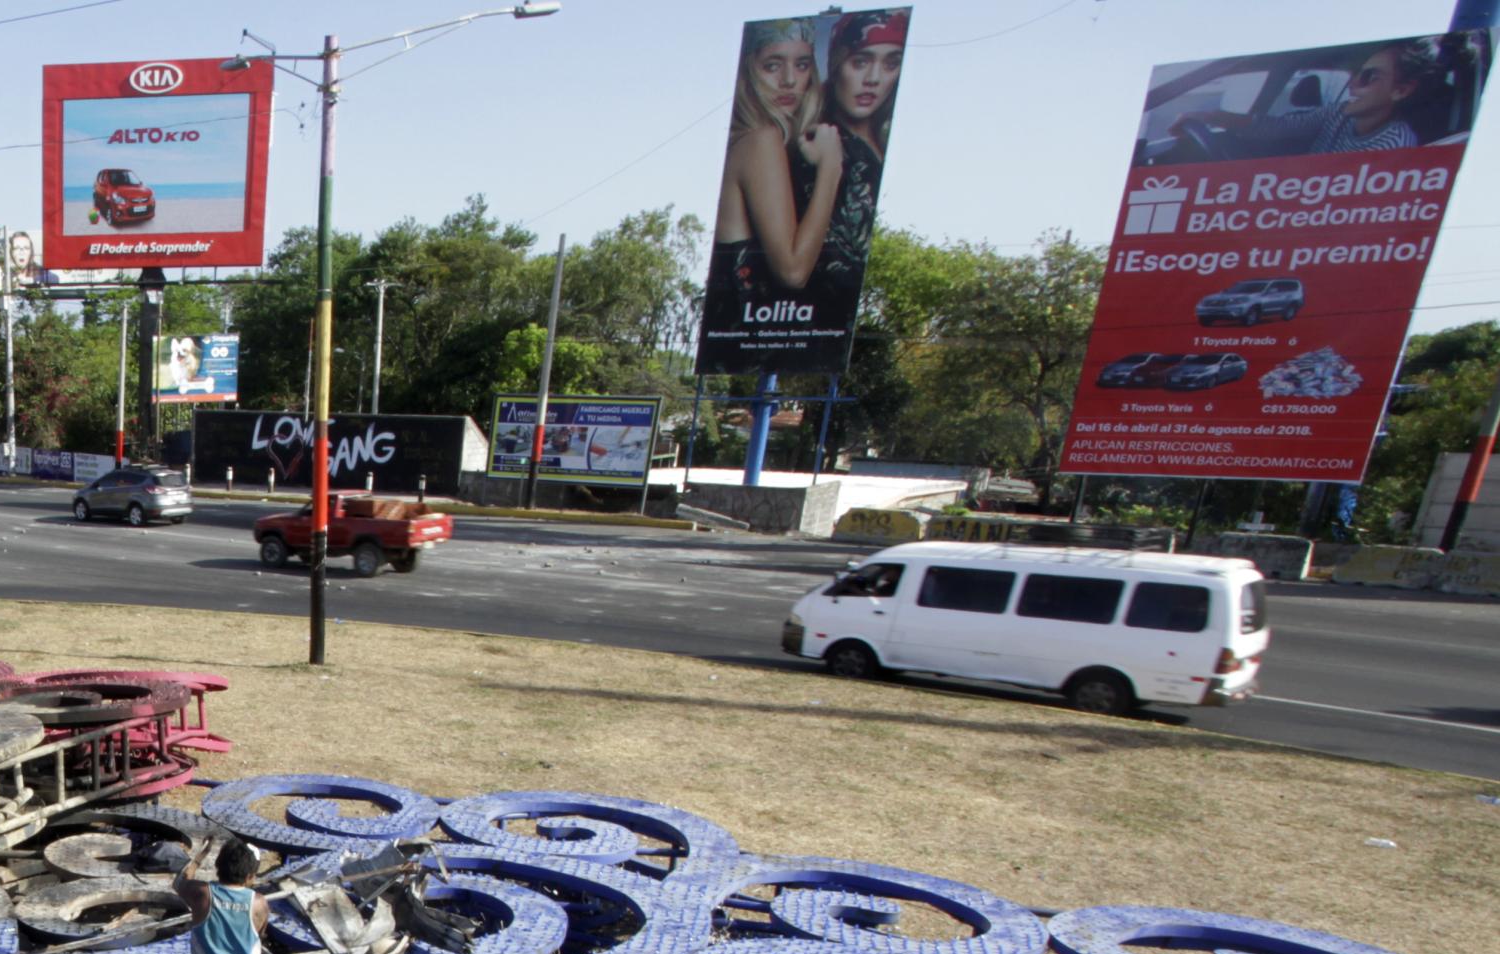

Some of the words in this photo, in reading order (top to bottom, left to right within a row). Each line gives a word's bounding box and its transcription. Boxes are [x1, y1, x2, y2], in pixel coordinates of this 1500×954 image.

[139, 69, 175, 88] KIA
[107, 127, 163, 145] ALTO
[1194, 177, 1240, 206] La
[1248, 163, 1449, 205] Regalona
[1186, 209, 1250, 234] BAC
[1255, 198, 1440, 230] Credomatic
[89, 243, 100, 255] El
[101, 243, 133, 254] Poder
[134, 242, 148, 253] de
[149, 240, 211, 255] Sorprender
[1113, 249, 1240, 276] ¡Escoge
[1248, 247, 1282, 268] tu
[1288, 236, 1432, 271] premio!
[743, 301, 814, 323] Lolita
[1193, 336, 1199, 347] 1
[1201, 336, 1240, 347] Toyota
[1241, 336, 1277, 346] Prado
[580, 405, 621, 414] FABRICAMOS
[621, 407, 650, 415] MUEBLES
[1121, 404, 1129, 412] 3
[1131, 403, 1166, 414] Toyota
[1168, 403, 1193, 413] Yaris
[1076, 422, 1097, 433] Del
[1098, 423, 1111, 433] 16
[1113, 423, 1129, 433] de
[1130, 423, 1158, 434] abril
[1159, 424, 1172, 434] al
[1173, 423, 1188, 434] 31
[1190, 424, 1205, 434] de
[1207, 425, 1252, 436] agosto
[1253, 424, 1275, 435] del
[1276, 425, 1313, 436] 2018.
[1071, 440, 1126, 451] APLICAN
[1127, 440, 1235, 453] RESTRICCIONES.
[1068, 452, 1154, 465] REGLAMENTO
[1156, 454, 1354, 470] WWW.BACCREDOMATIC.COM
